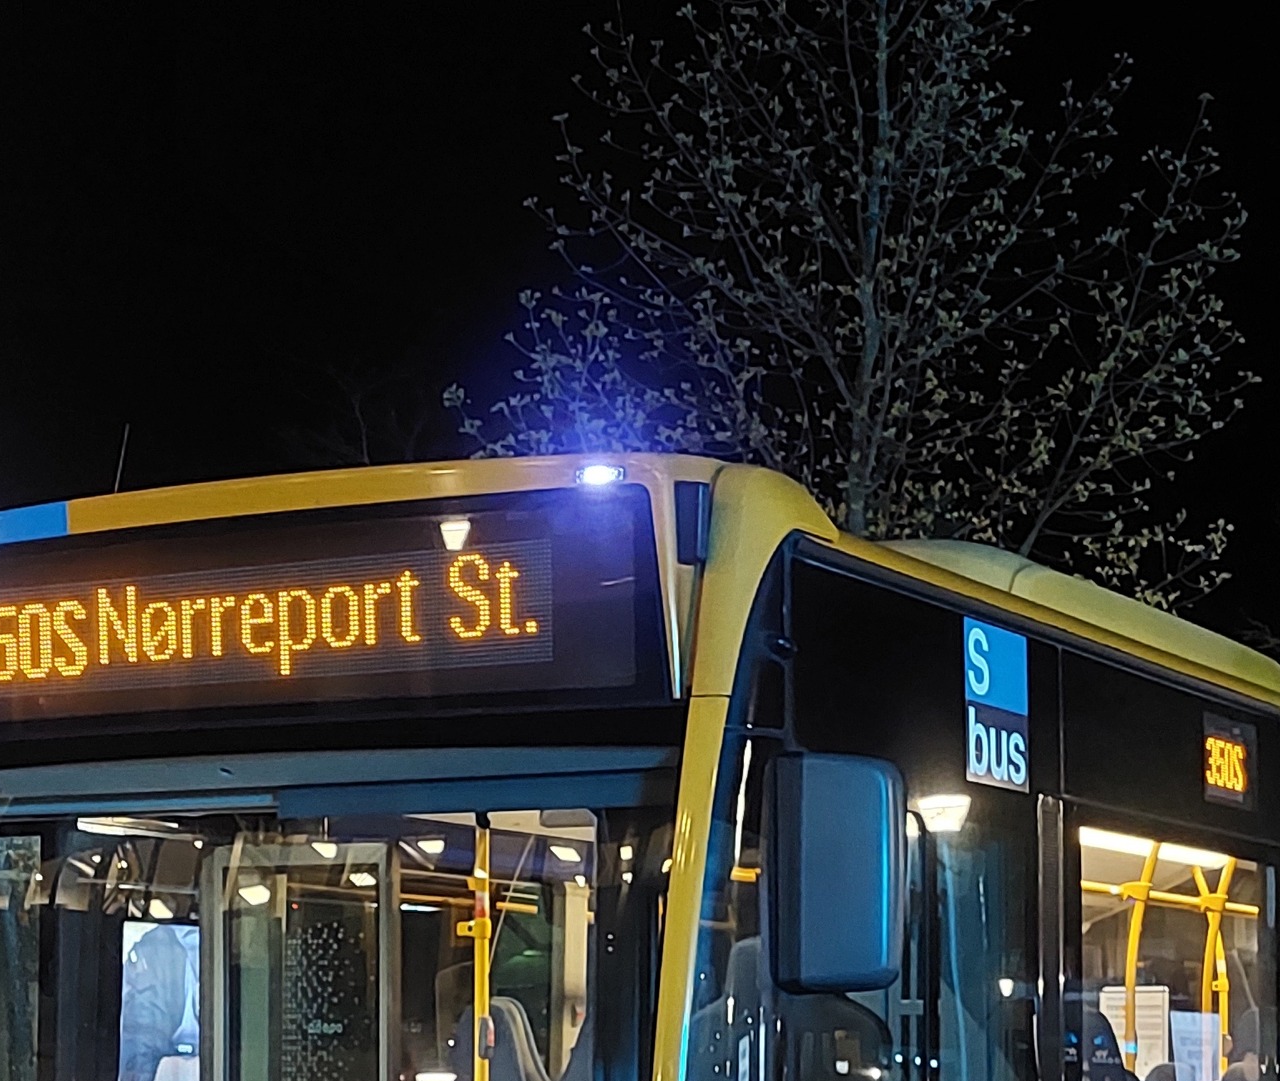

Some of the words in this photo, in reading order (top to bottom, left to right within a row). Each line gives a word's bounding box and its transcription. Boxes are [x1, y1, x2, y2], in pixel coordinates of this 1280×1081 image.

[96, 569, 422, 676] Nørreport
[448, 554, 538, 639] St.
[967, 627, 990, 696] S
[967, 705, 1027, 785] bus
[1205, 737, 1244, 792] 350S
